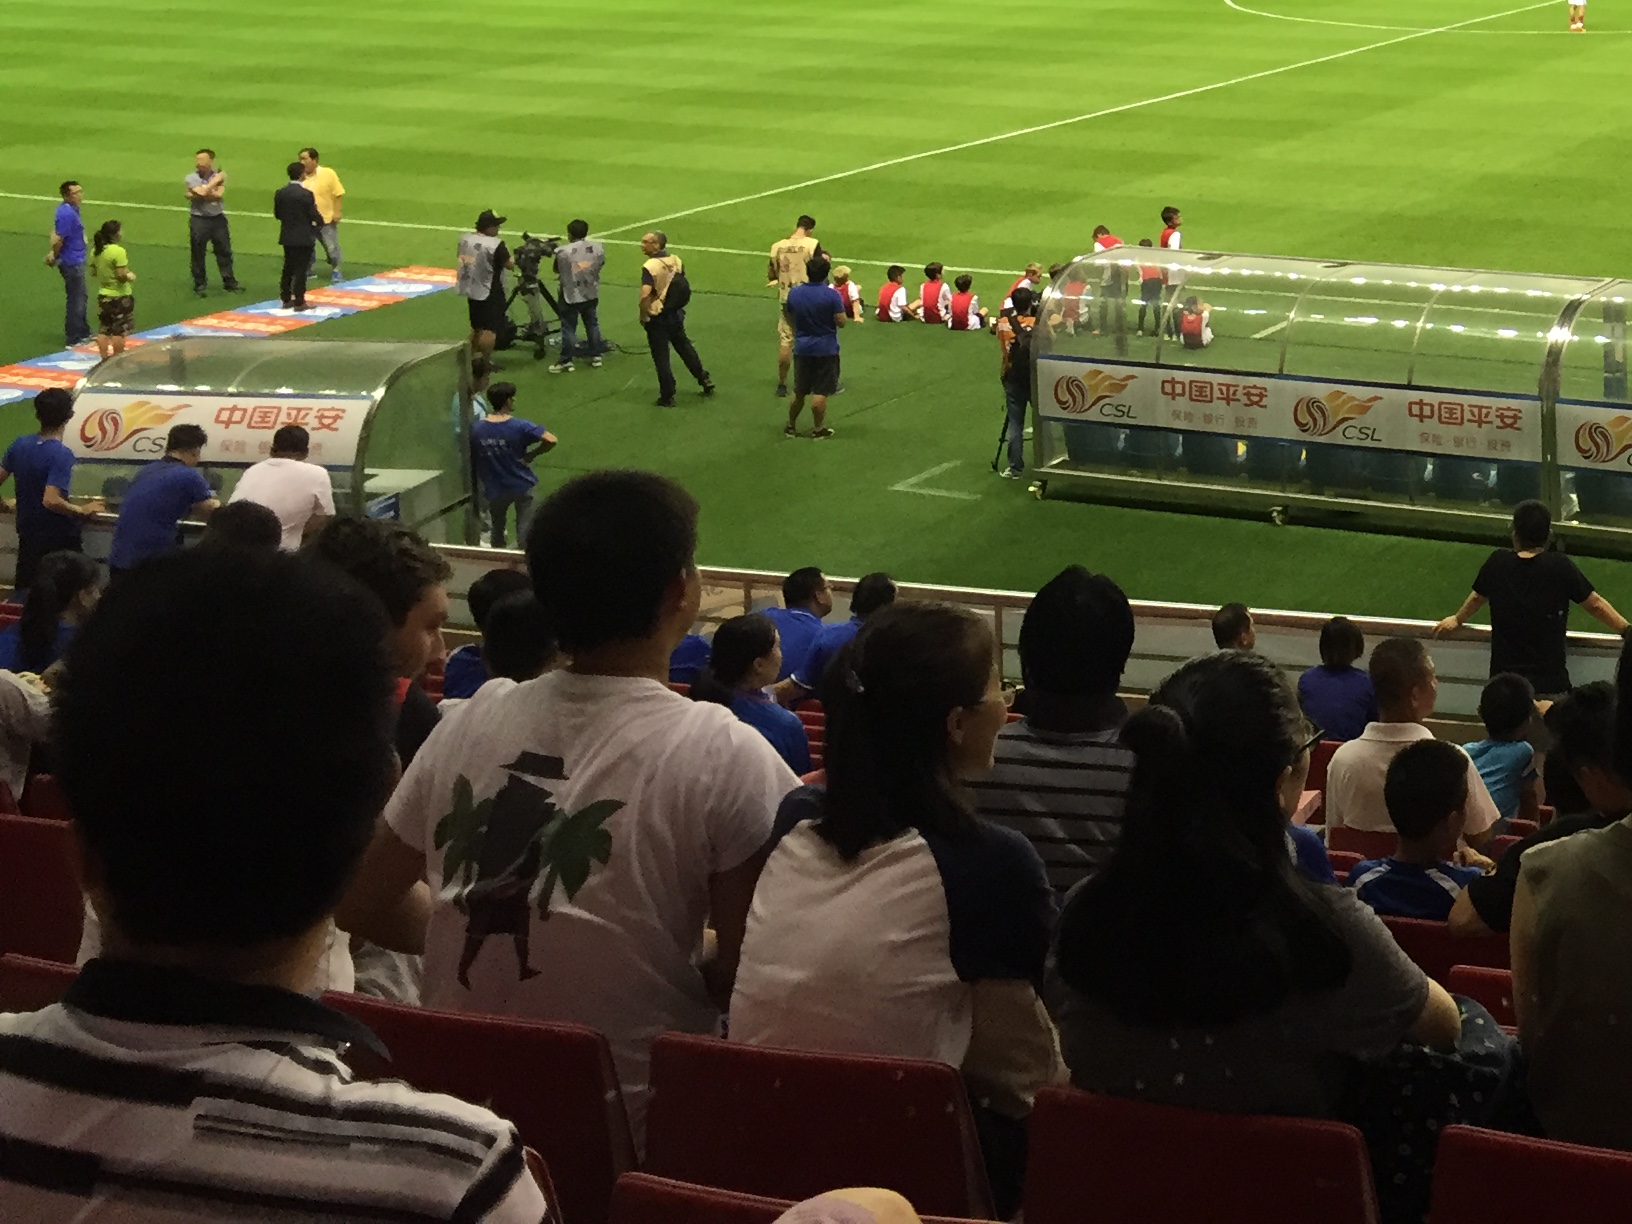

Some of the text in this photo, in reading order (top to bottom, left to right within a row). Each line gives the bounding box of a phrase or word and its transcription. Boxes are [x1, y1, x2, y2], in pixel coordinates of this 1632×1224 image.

[1161, 377, 1268, 409] 中国平安
[214, 404, 346, 432] 中国平安
[1100, 403, 1137, 419] CSL
[1407, 398, 1523, 431] 中国平安
[1342, 425, 1382, 442] CSL
[133, 437, 167, 453] CS
